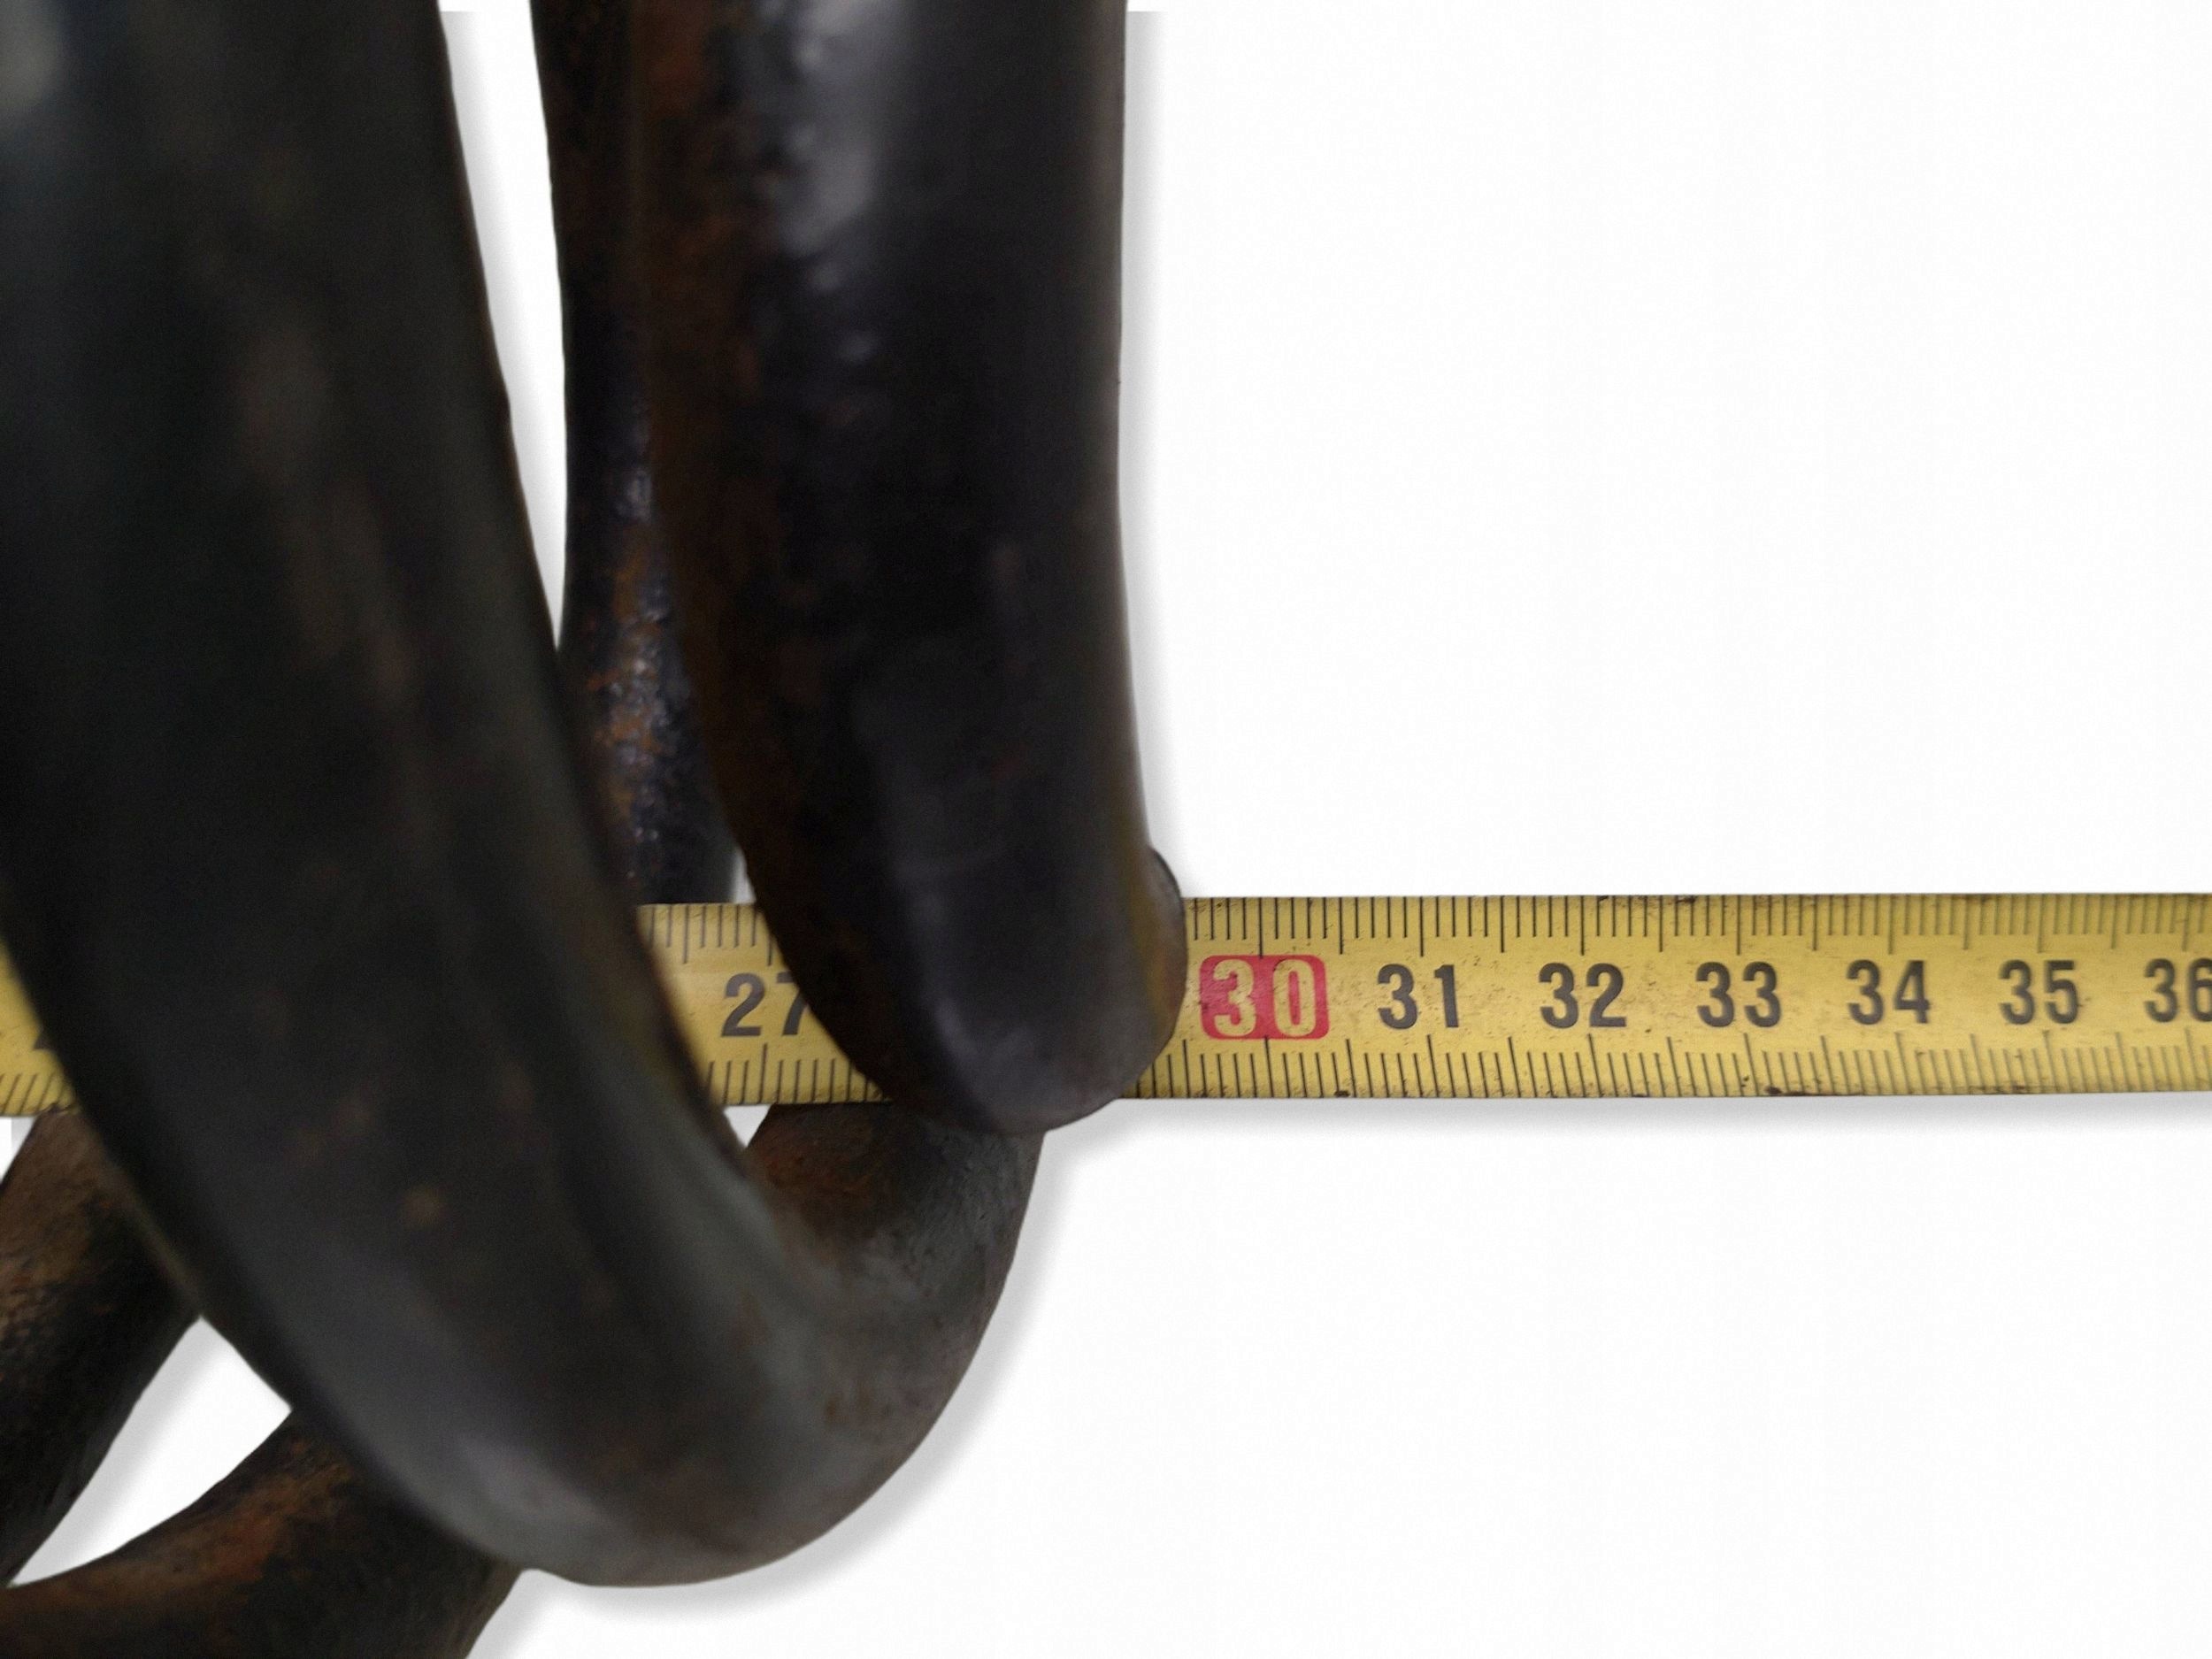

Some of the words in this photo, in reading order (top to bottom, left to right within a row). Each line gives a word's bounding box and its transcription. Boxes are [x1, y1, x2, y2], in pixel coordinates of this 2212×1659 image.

[720, 972, 809, 1037] 27
[1211, 958, 1317, 1036] 30
[1377, 964, 1460, 1029] 31
[1538, 963, 1626, 1029] 32
[1695, 961, 1782, 1028] 33
[1846, 959, 1931, 1025] 34
[1998, 959, 2078, 1025] 35
[2144, 957, 2212, 1023] 36
